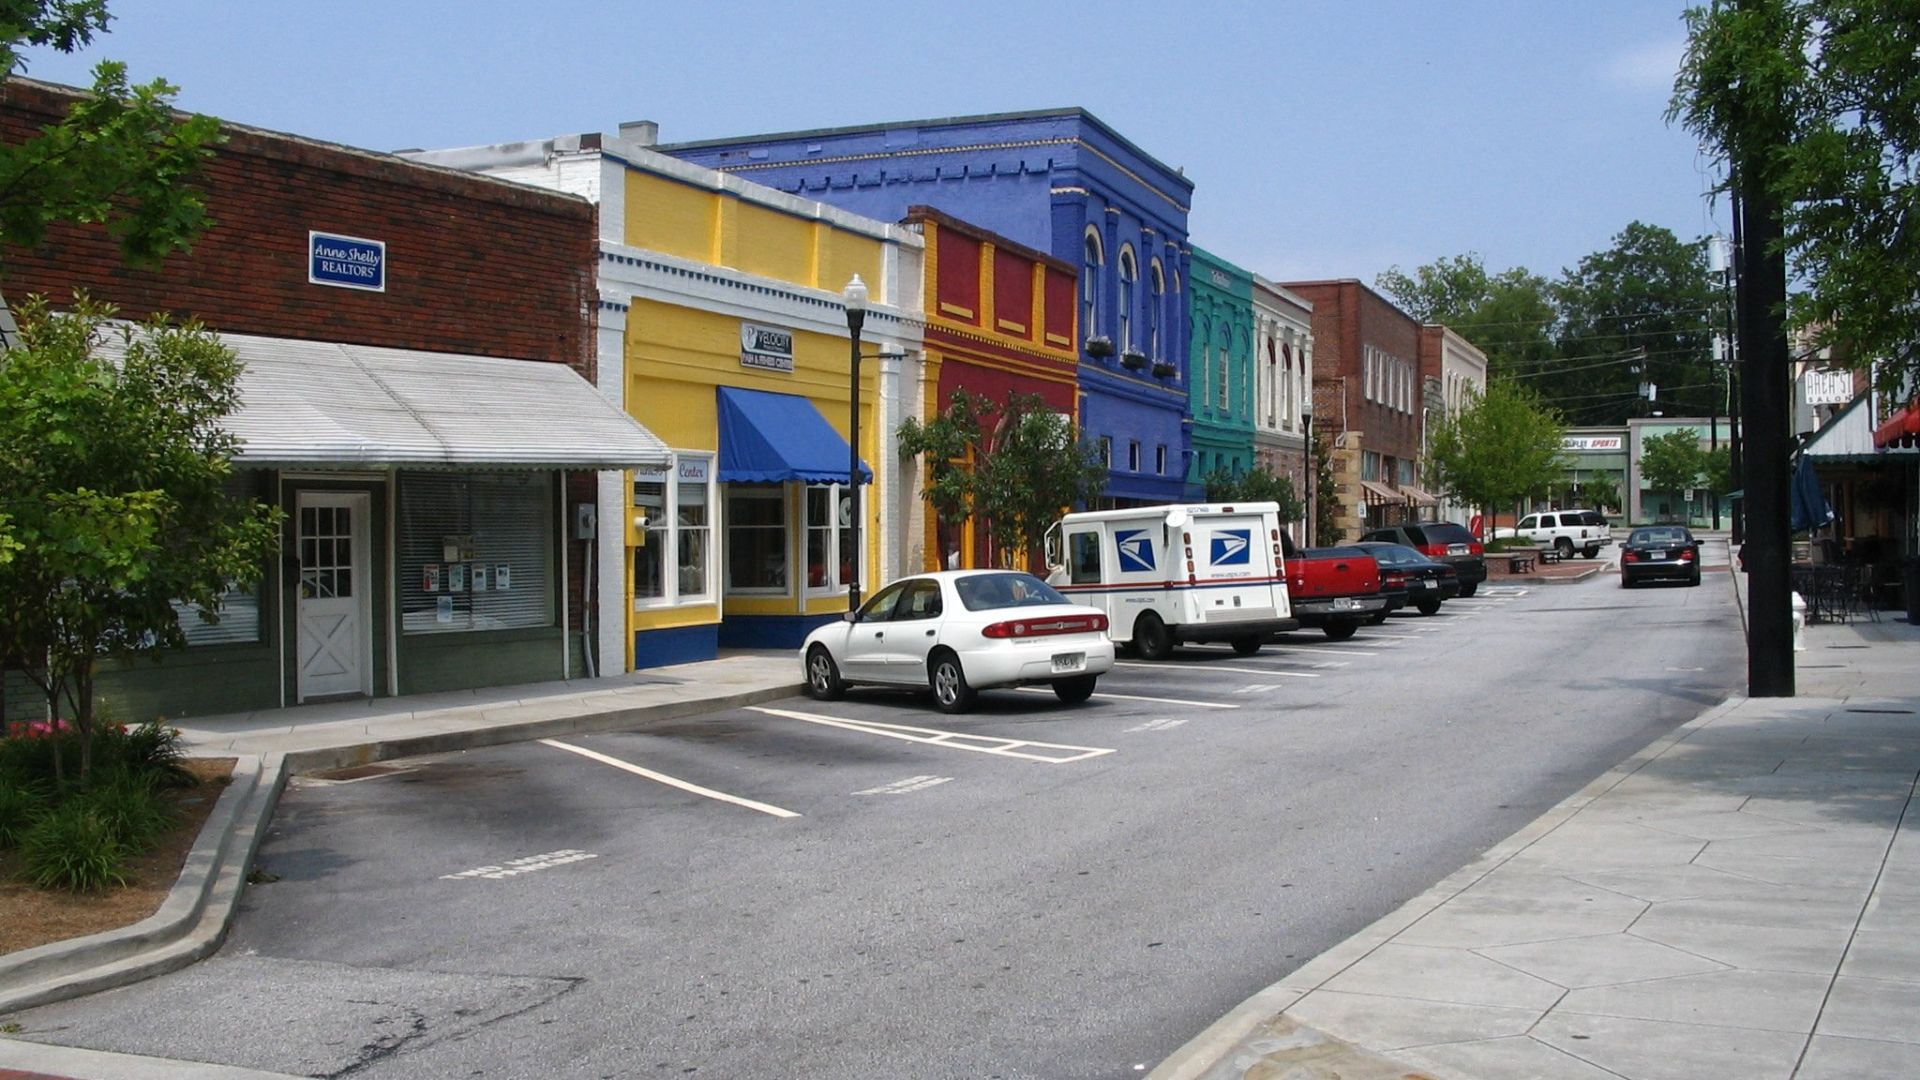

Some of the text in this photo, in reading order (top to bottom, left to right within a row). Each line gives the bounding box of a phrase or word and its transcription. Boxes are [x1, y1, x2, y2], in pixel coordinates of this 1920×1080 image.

[315, 244, 380, 267] Anne Shelly
[758, 331, 790, 348] VELOCITY
[1808, 394, 1852, 403] SALON
[1591, 439, 1619, 448] SPORTS
[679, 462, 704, 478] Center
